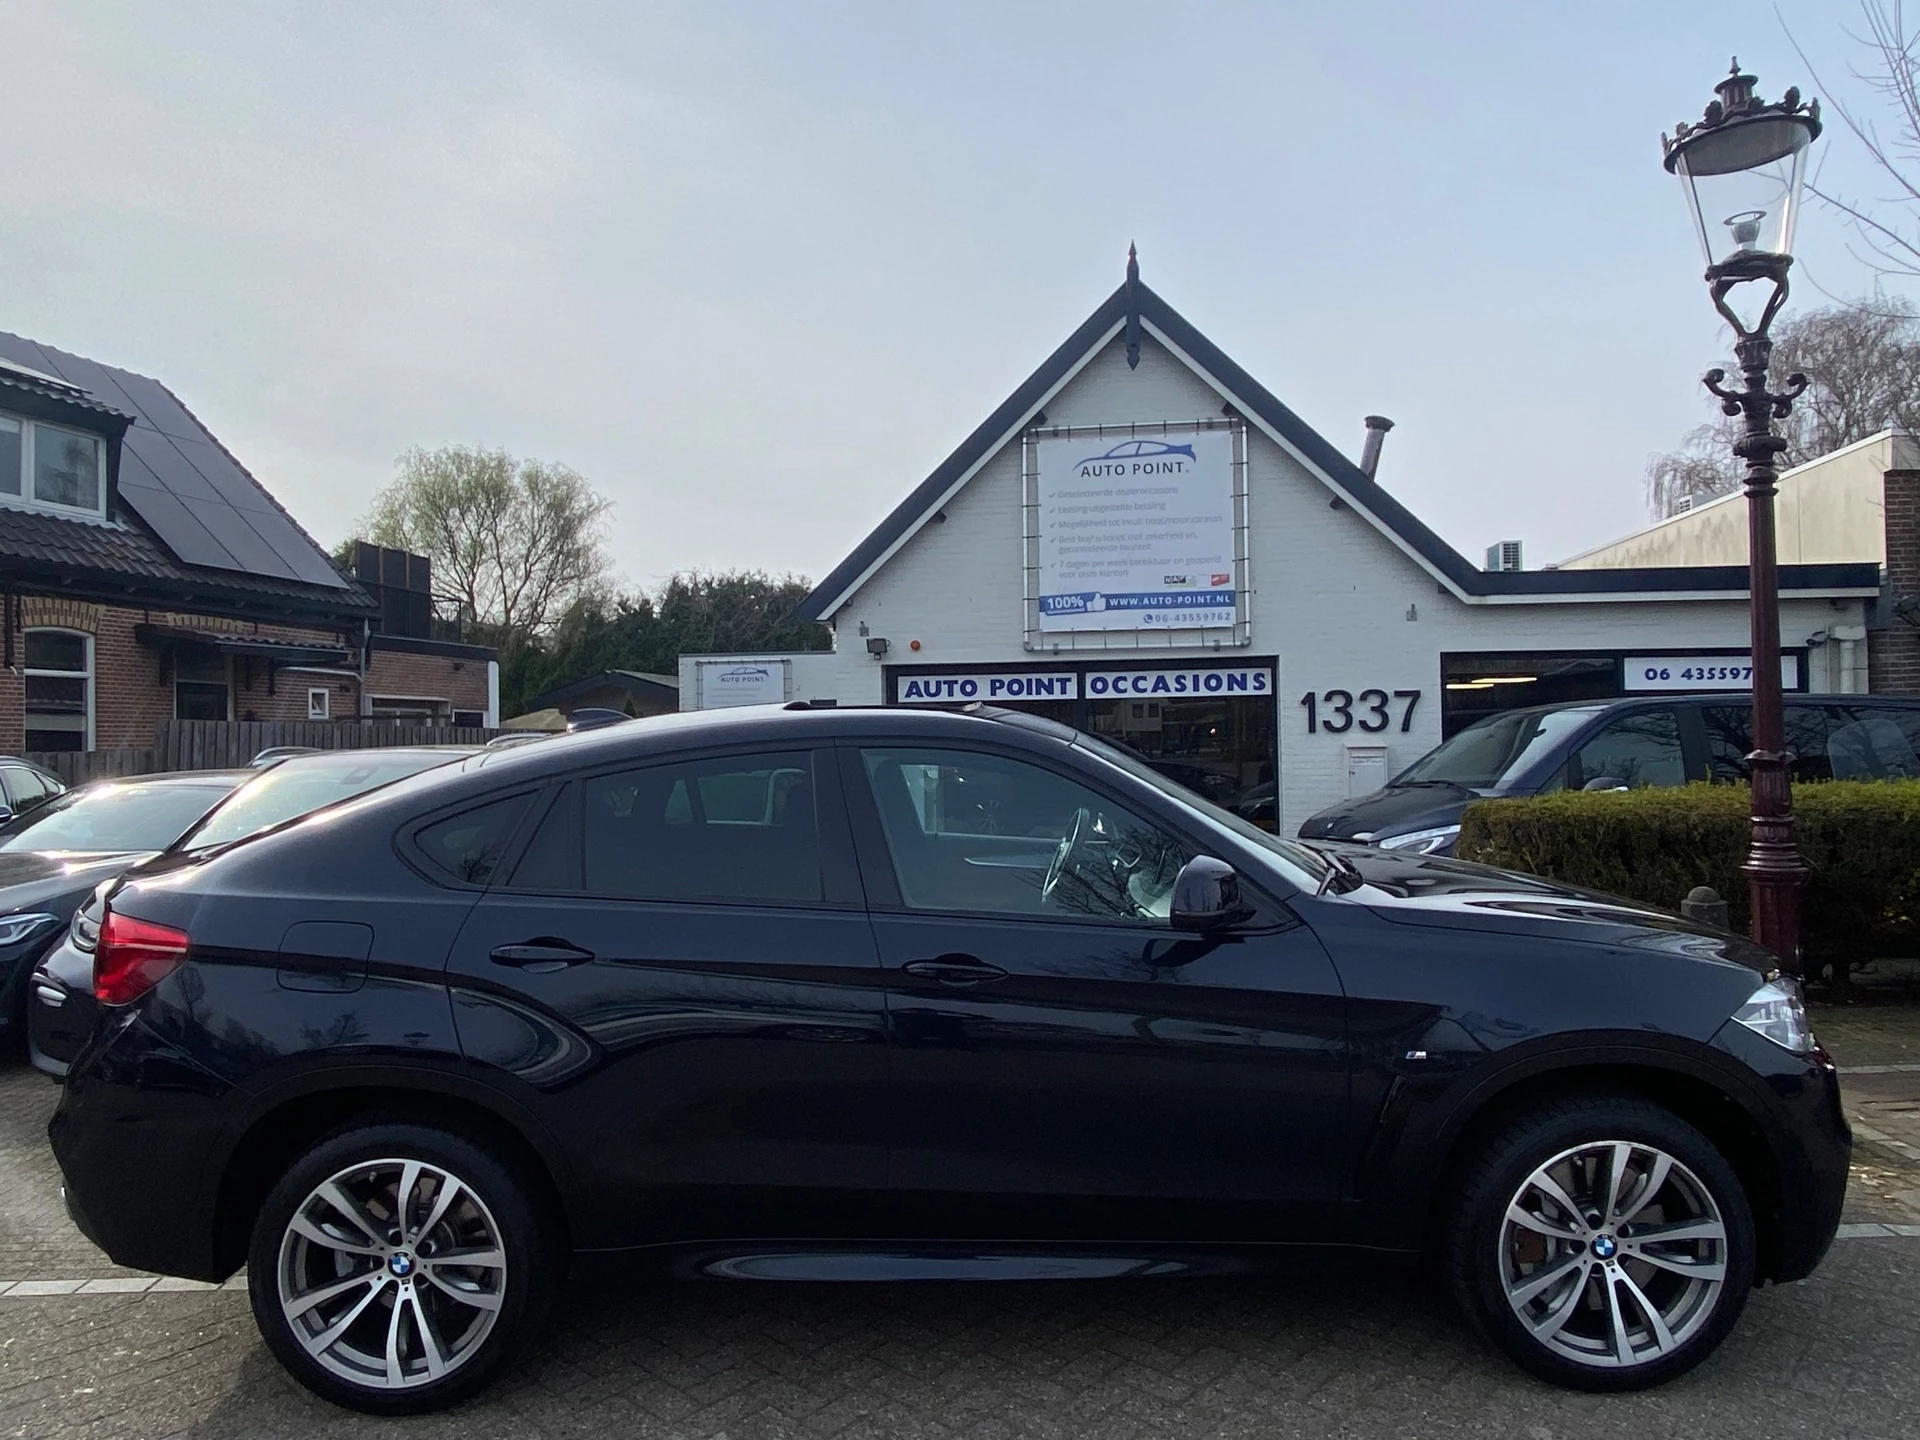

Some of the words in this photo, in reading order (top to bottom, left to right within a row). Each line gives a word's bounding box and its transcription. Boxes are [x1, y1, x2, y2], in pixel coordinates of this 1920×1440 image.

[1081, 464, 1126, 478] AUTO
[1132, 461, 1184, 475] POINT
[1047, 595, 1084, 609] 100%
[1109, 594, 1231, 606] WWW.AUTO-POINT.NL
[1644, 668, 1671, 681] 06
[1680, 666, 1754, 680] 435597
[905, 679, 978, 698] AUTO
[990, 677, 1072, 697] POINT
[1090, 672, 1266, 694] OCCASIONS
[1300, 688, 1422, 734] 1337
